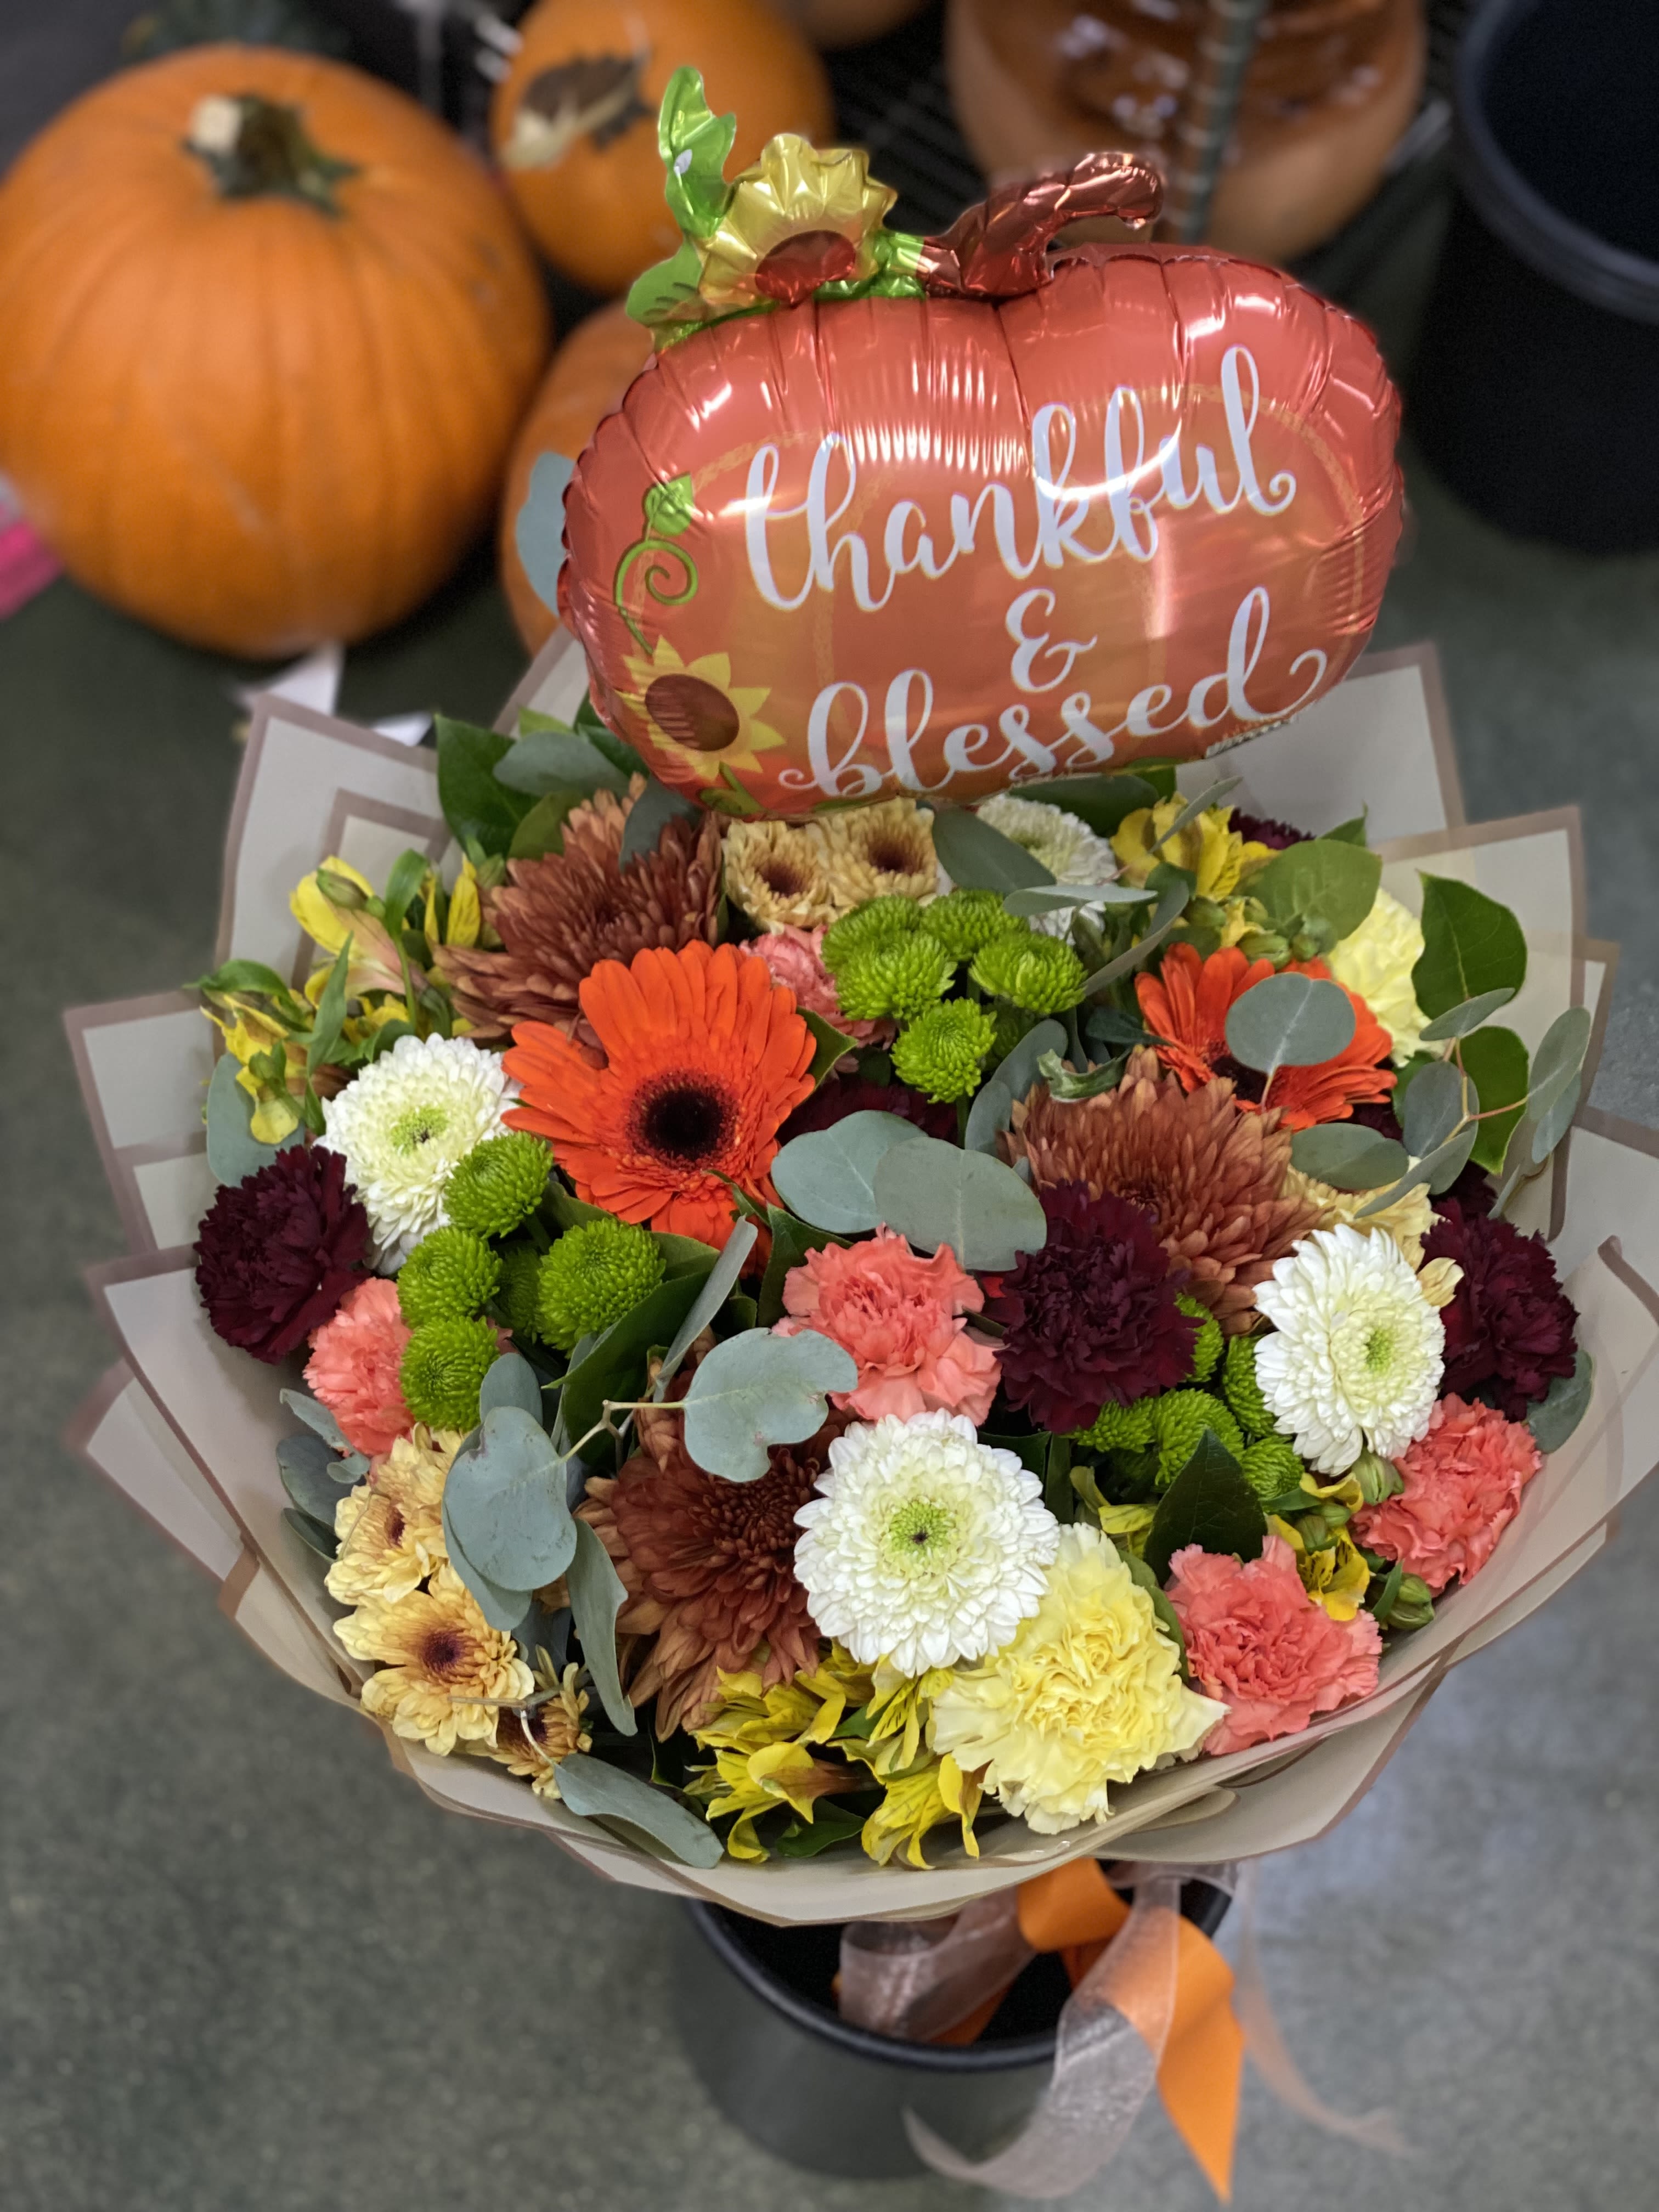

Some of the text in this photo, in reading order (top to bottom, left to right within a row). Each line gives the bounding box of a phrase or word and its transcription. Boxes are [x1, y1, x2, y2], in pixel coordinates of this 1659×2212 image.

[722, 345, 1296, 611] thankful
[778, 586, 1327, 797] blessed
[1005, 588, 1097, 693] &
